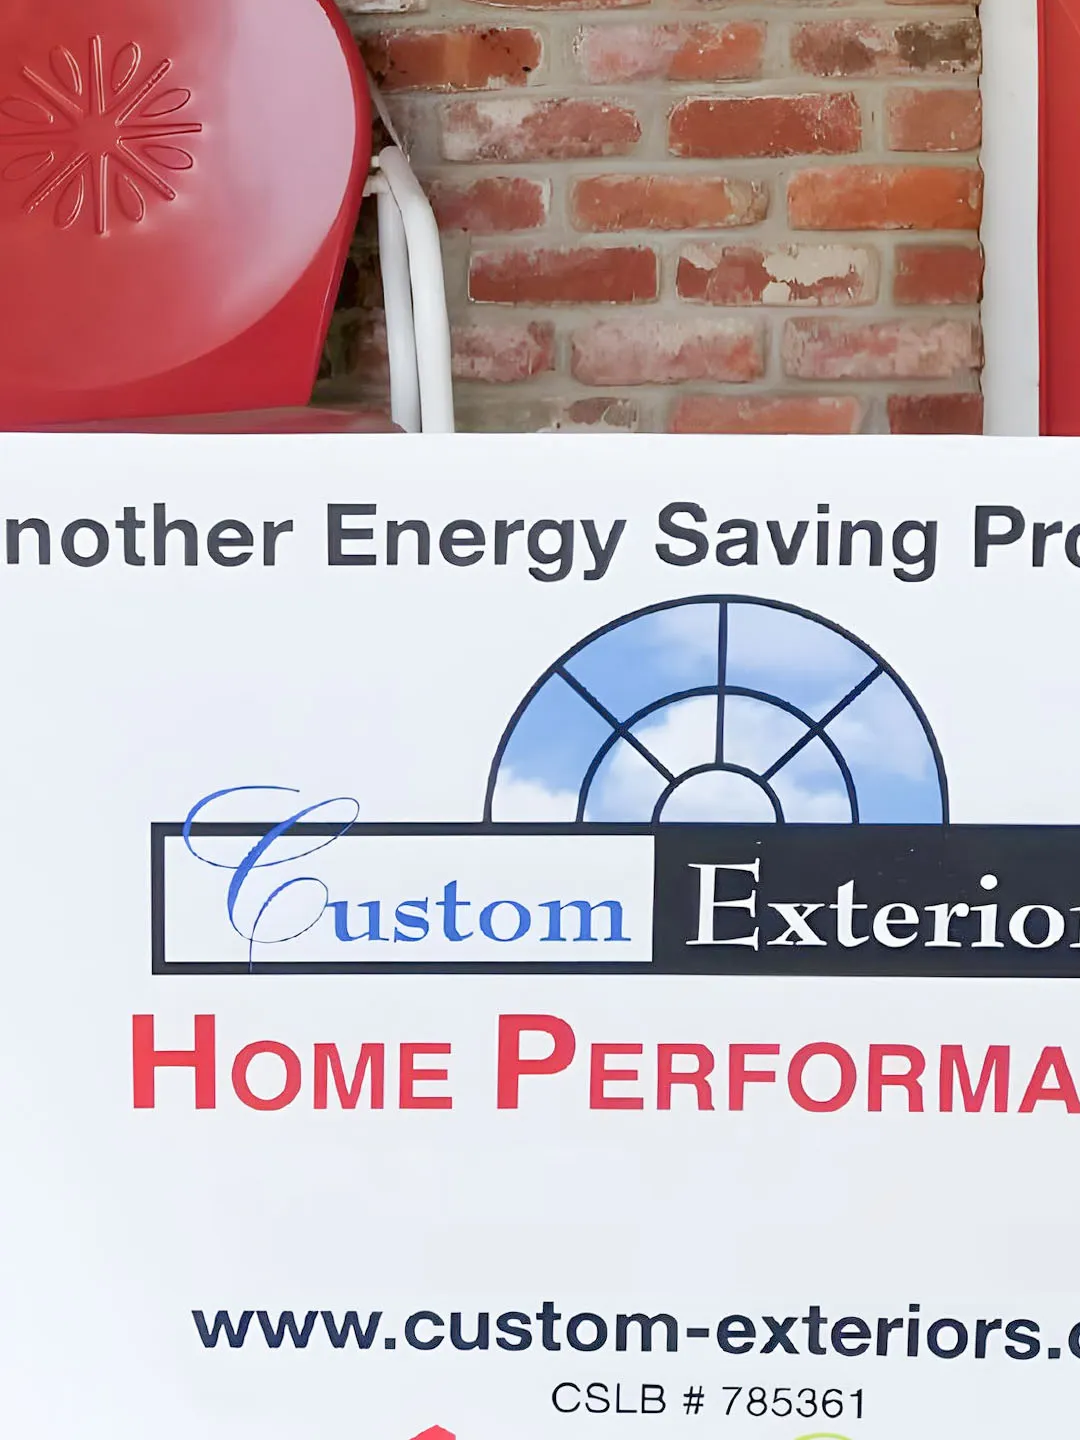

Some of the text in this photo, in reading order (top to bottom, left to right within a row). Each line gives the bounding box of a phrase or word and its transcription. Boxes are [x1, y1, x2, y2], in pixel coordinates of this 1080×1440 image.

[327, 503, 628, 583] Energy
[655, 501, 939, 583] Saving
[182, 785, 632, 973] Custom
[132, 1014, 454, 1113] HOME
[551, 1381, 865, 1420] CSLB # 785361
